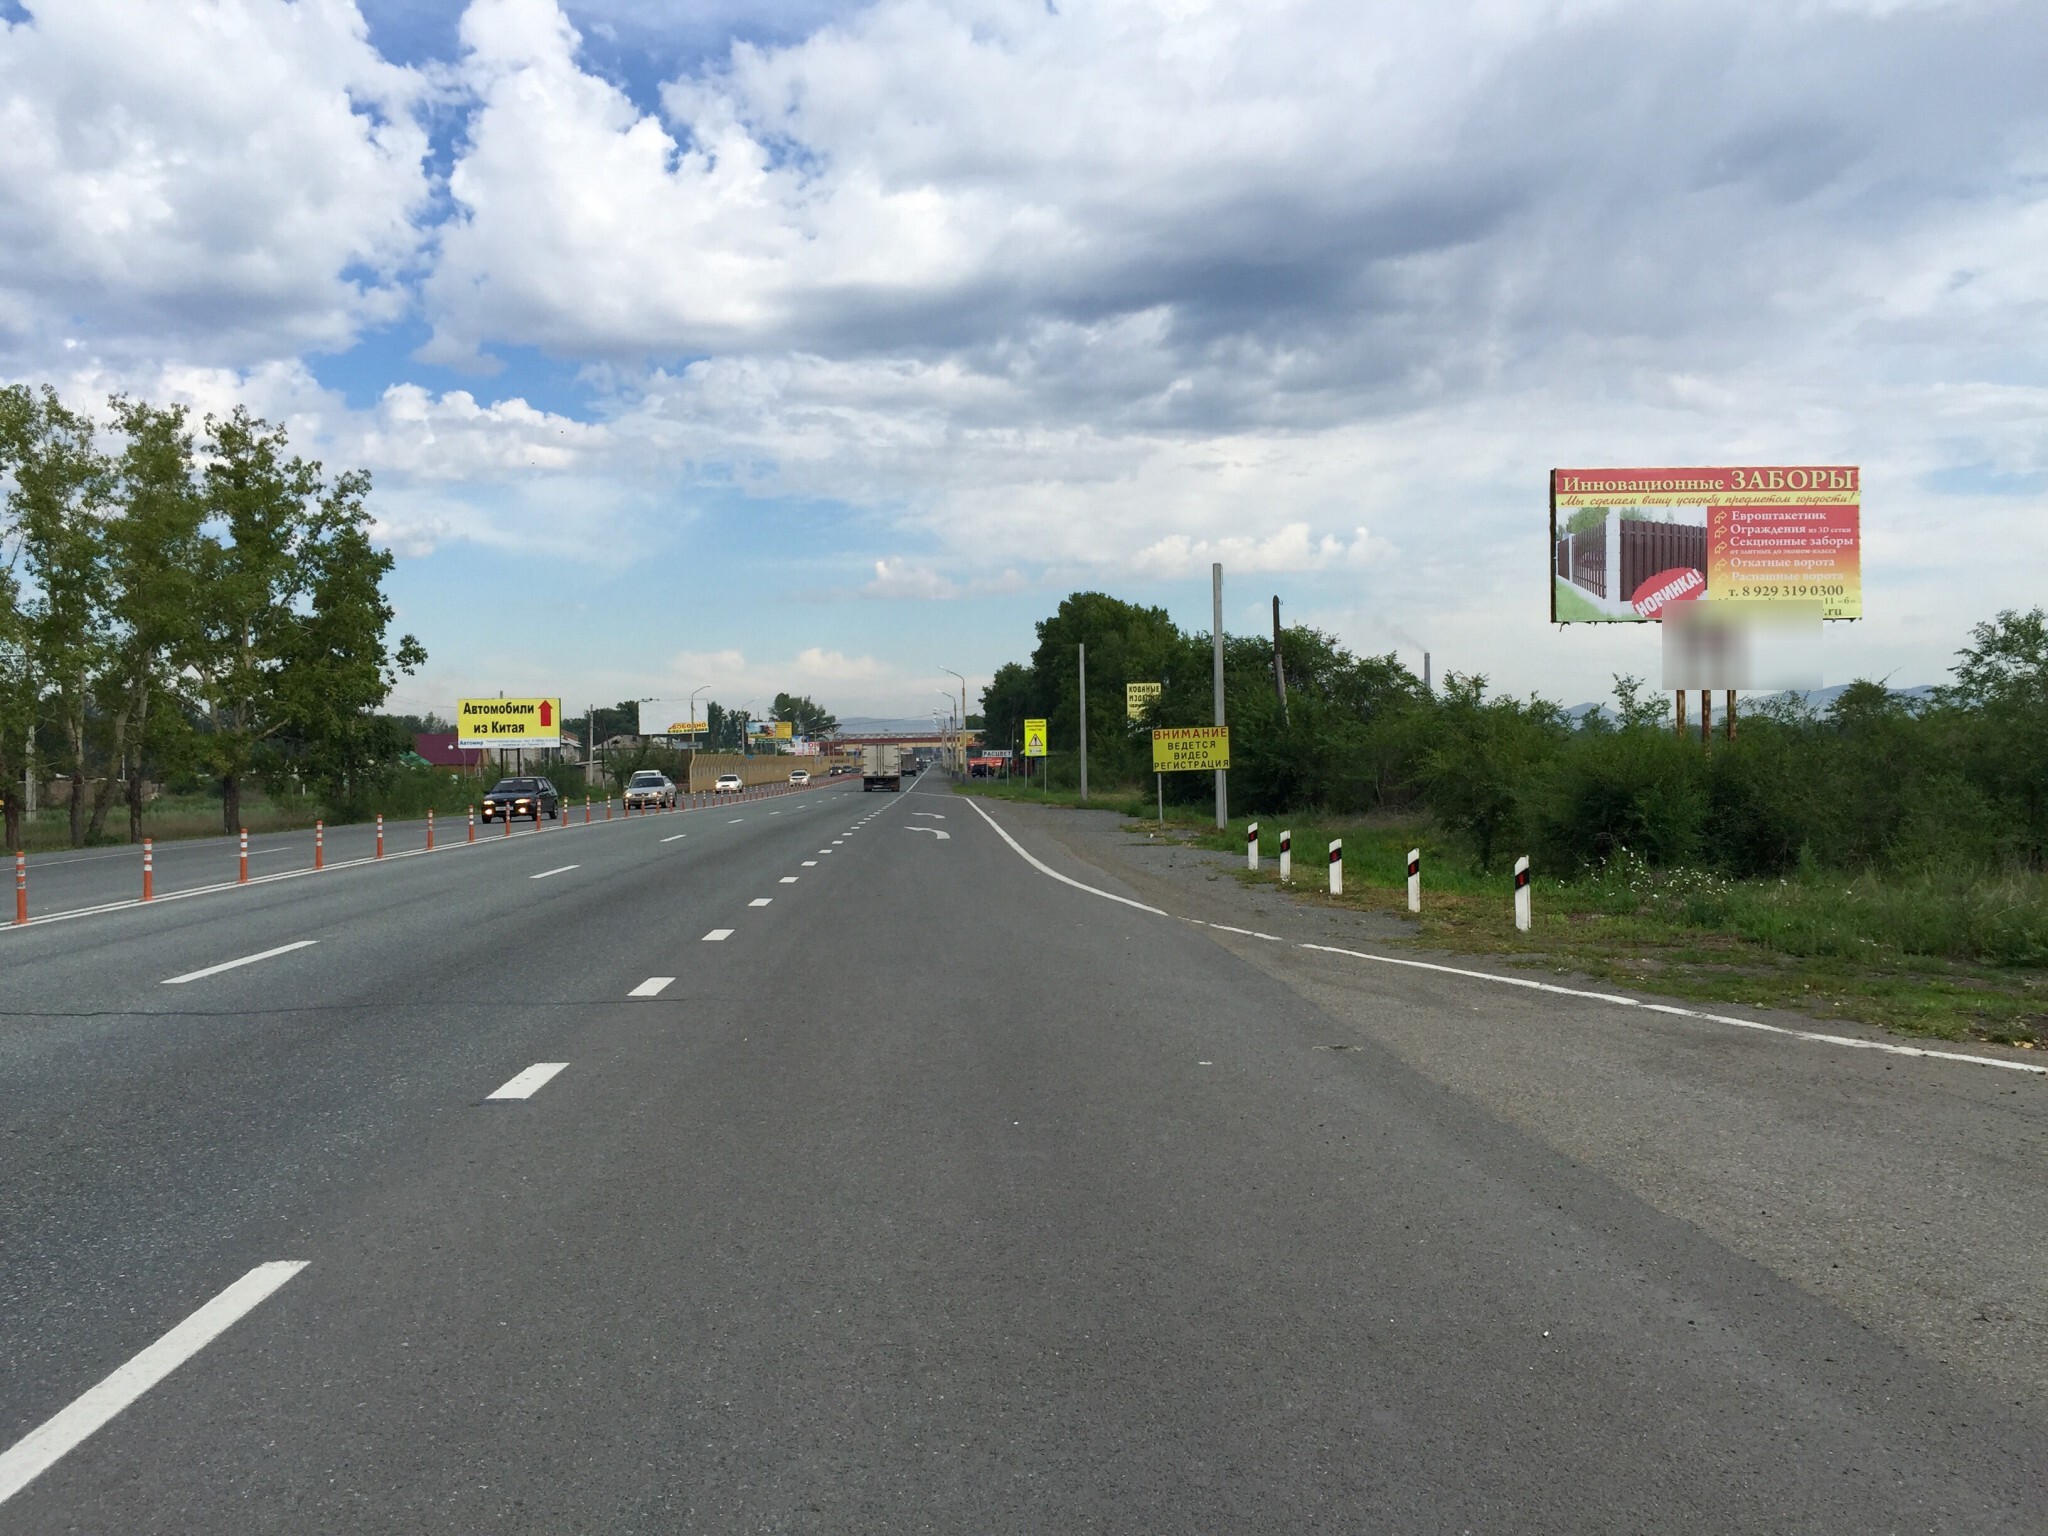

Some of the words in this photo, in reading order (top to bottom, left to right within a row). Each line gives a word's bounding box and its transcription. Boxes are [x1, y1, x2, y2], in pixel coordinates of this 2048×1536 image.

[1563, 477, 1724, 492] Инновационные
[1730, 470, 1854, 489] ЗАБОРЫ
[1561, 495, 1584, 506] Мы
[1590, 496, 1636, 507] сделаем
[1642, 495, 1672, 507] вашу
[1676, 494, 1720, 507] усадьбу
[1725, 494, 1791, 506] предметом
[1796, 492, 1855, 506] гордости!
[1732, 510, 1826, 522] Евроштакетник
[1730, 523, 1806, 535] Ограждения
[1730, 536, 1807, 547] Секционные
[1809, 536, 1854, 548] заборы
[1730, 557, 1791, 567] Откатные
[1794, 559, 1835, 569] ворота
[1732, 572, 1800, 581] Распашные
[1803, 573, 1844, 583] ворота
[1728, 588, 1739, 597] т.
[1742, 586, 1750, 596] 8
[1753, 585, 1778, 597] 929
[1782, 585, 1807, 597] 319
[1810, 585, 1844, 597] 0300
[1128, 685, 1160, 693] КОВАНЫЕ
[463, 701, 534, 715] Автомобили
[473, 724, 488, 734] из
[491, 721, 525, 734] Китая
[1153, 727, 1227, 740] ВНИМАНИЕ
[1167, 740, 1216, 750] ВЕДЕТСЯ
[1174, 751, 1208, 760] ВИДЕО
[1154, 759, 1229, 770] РЕГИСТРАЦИЯ
